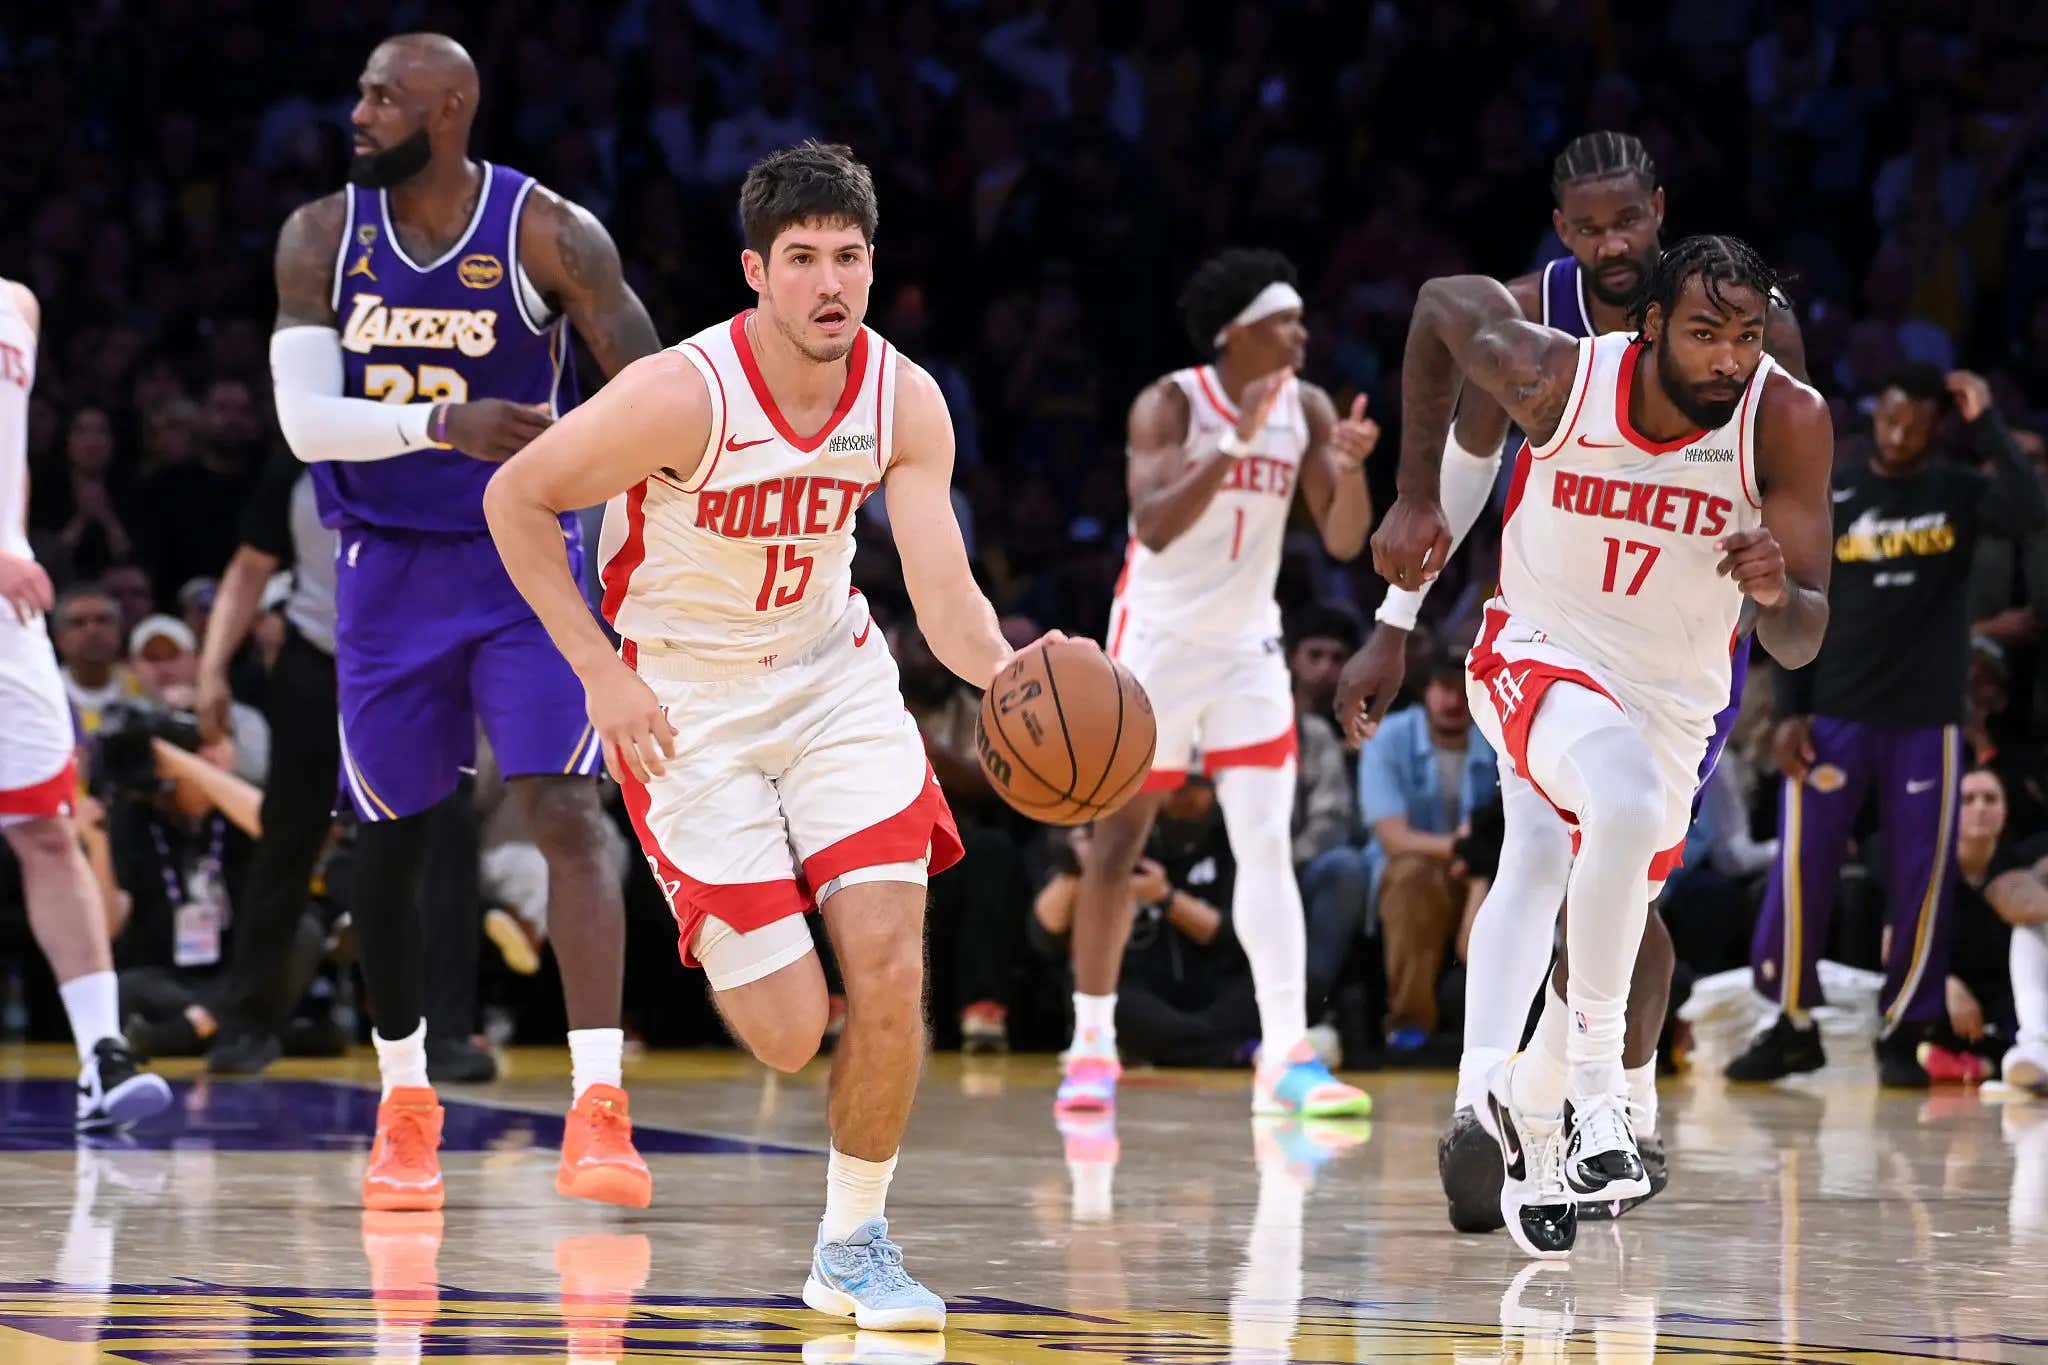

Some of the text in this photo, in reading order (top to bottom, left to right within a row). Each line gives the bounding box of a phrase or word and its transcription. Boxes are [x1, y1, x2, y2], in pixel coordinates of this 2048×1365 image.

[342, 293, 497, 357] LAKERS
[1231, 506, 1244, 560] 1
[1552, 470, 1733, 537] ROCKETS
[755, 544, 814, 612] 15
[1601, 537, 1662, 597] 17
